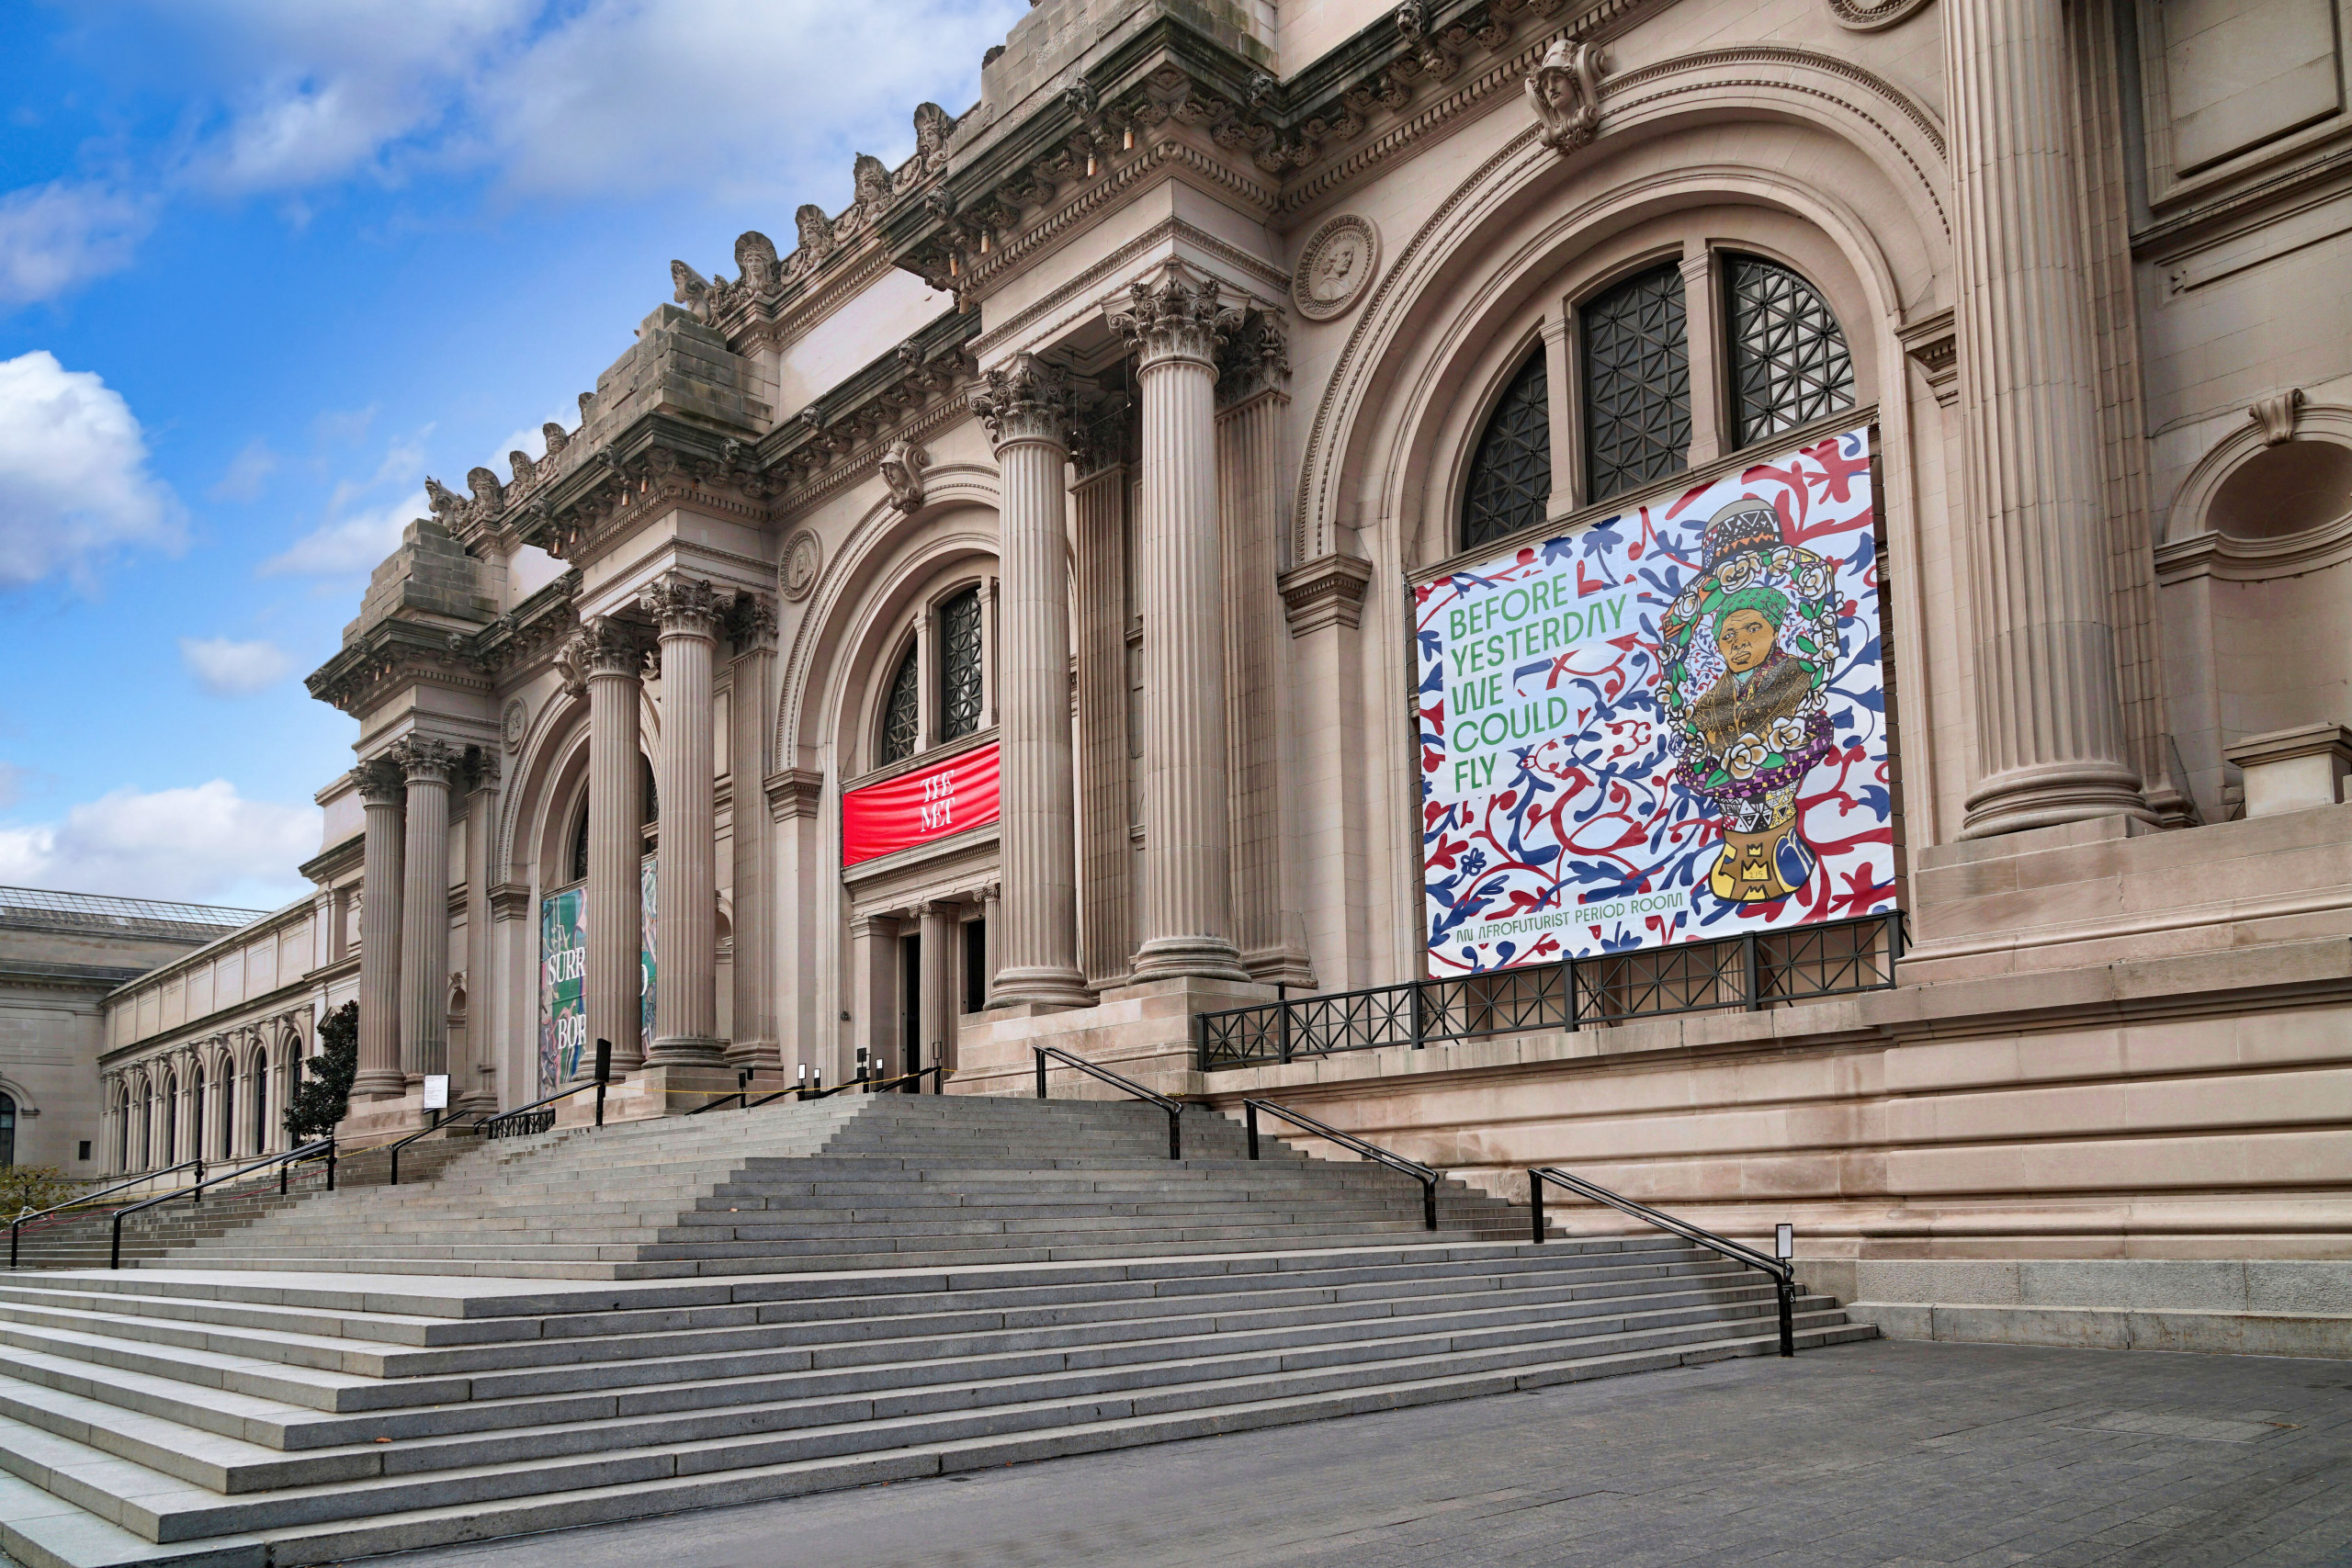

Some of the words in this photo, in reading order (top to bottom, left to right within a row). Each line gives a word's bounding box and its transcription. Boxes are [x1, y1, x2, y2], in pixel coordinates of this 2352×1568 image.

[1450, 572, 1567, 641] BEFORE
[1451, 593, 1627, 677] YESTERDAY
[1452, 671, 1504, 716] WE
[1453, 696, 1567, 753] COULD
[919, 769, 956, 803] THE
[1454, 752, 1498, 794] FLY
[920, 796, 956, 833] MET
[1456, 929, 1474, 943] AN
[1478, 911, 1570, 940] AFROFUTURIST
[1575, 902, 1625, 924] PERIOD
[1631, 892, 1683, 915] ROOM
